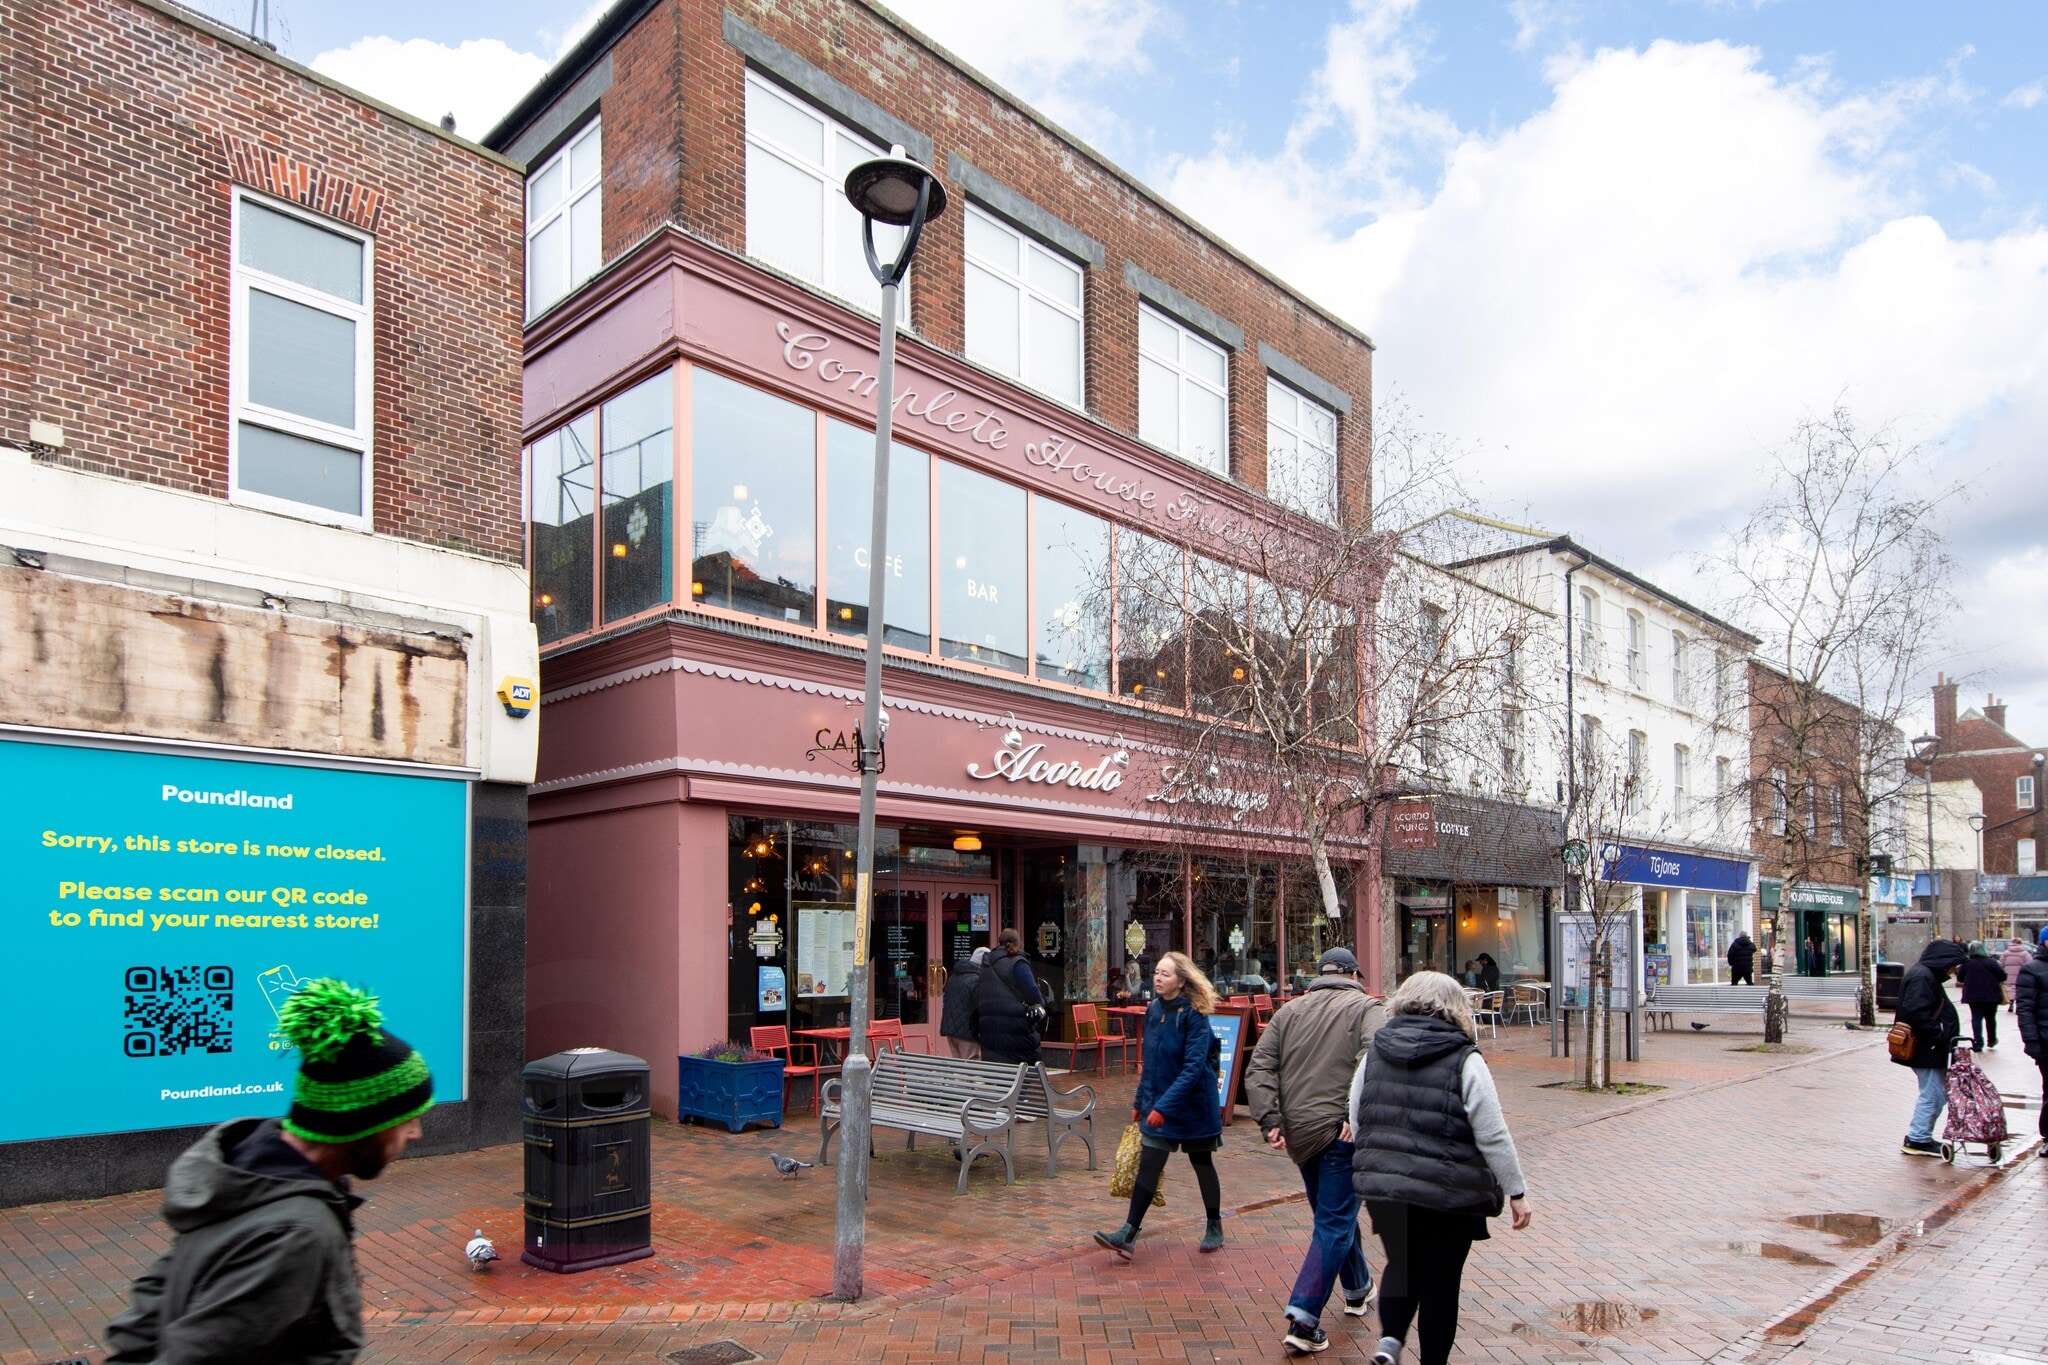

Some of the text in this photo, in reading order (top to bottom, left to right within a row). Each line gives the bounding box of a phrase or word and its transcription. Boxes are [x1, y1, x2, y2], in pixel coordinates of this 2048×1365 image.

[775, 321, 1158, 511] Complete House
[967, 579, 999, 604] BAR
[513, 687, 530, 699] ADT
[967, 743, 1124, 792] Acordo
[162, 784, 293, 810] Poundland
[1393, 812, 1430, 822] ACORDO
[41, 830, 386, 862] Sorry, this store is now closed.
[1650, 856, 1680, 878] TGJones
[59, 881, 368, 907] Please scan our QR code
[1815, 894, 1844, 905] WAREHOUSE
[48, 908, 379, 931] to find your nearest store!
[161, 1081, 284, 1101] Poundland.co.uk
